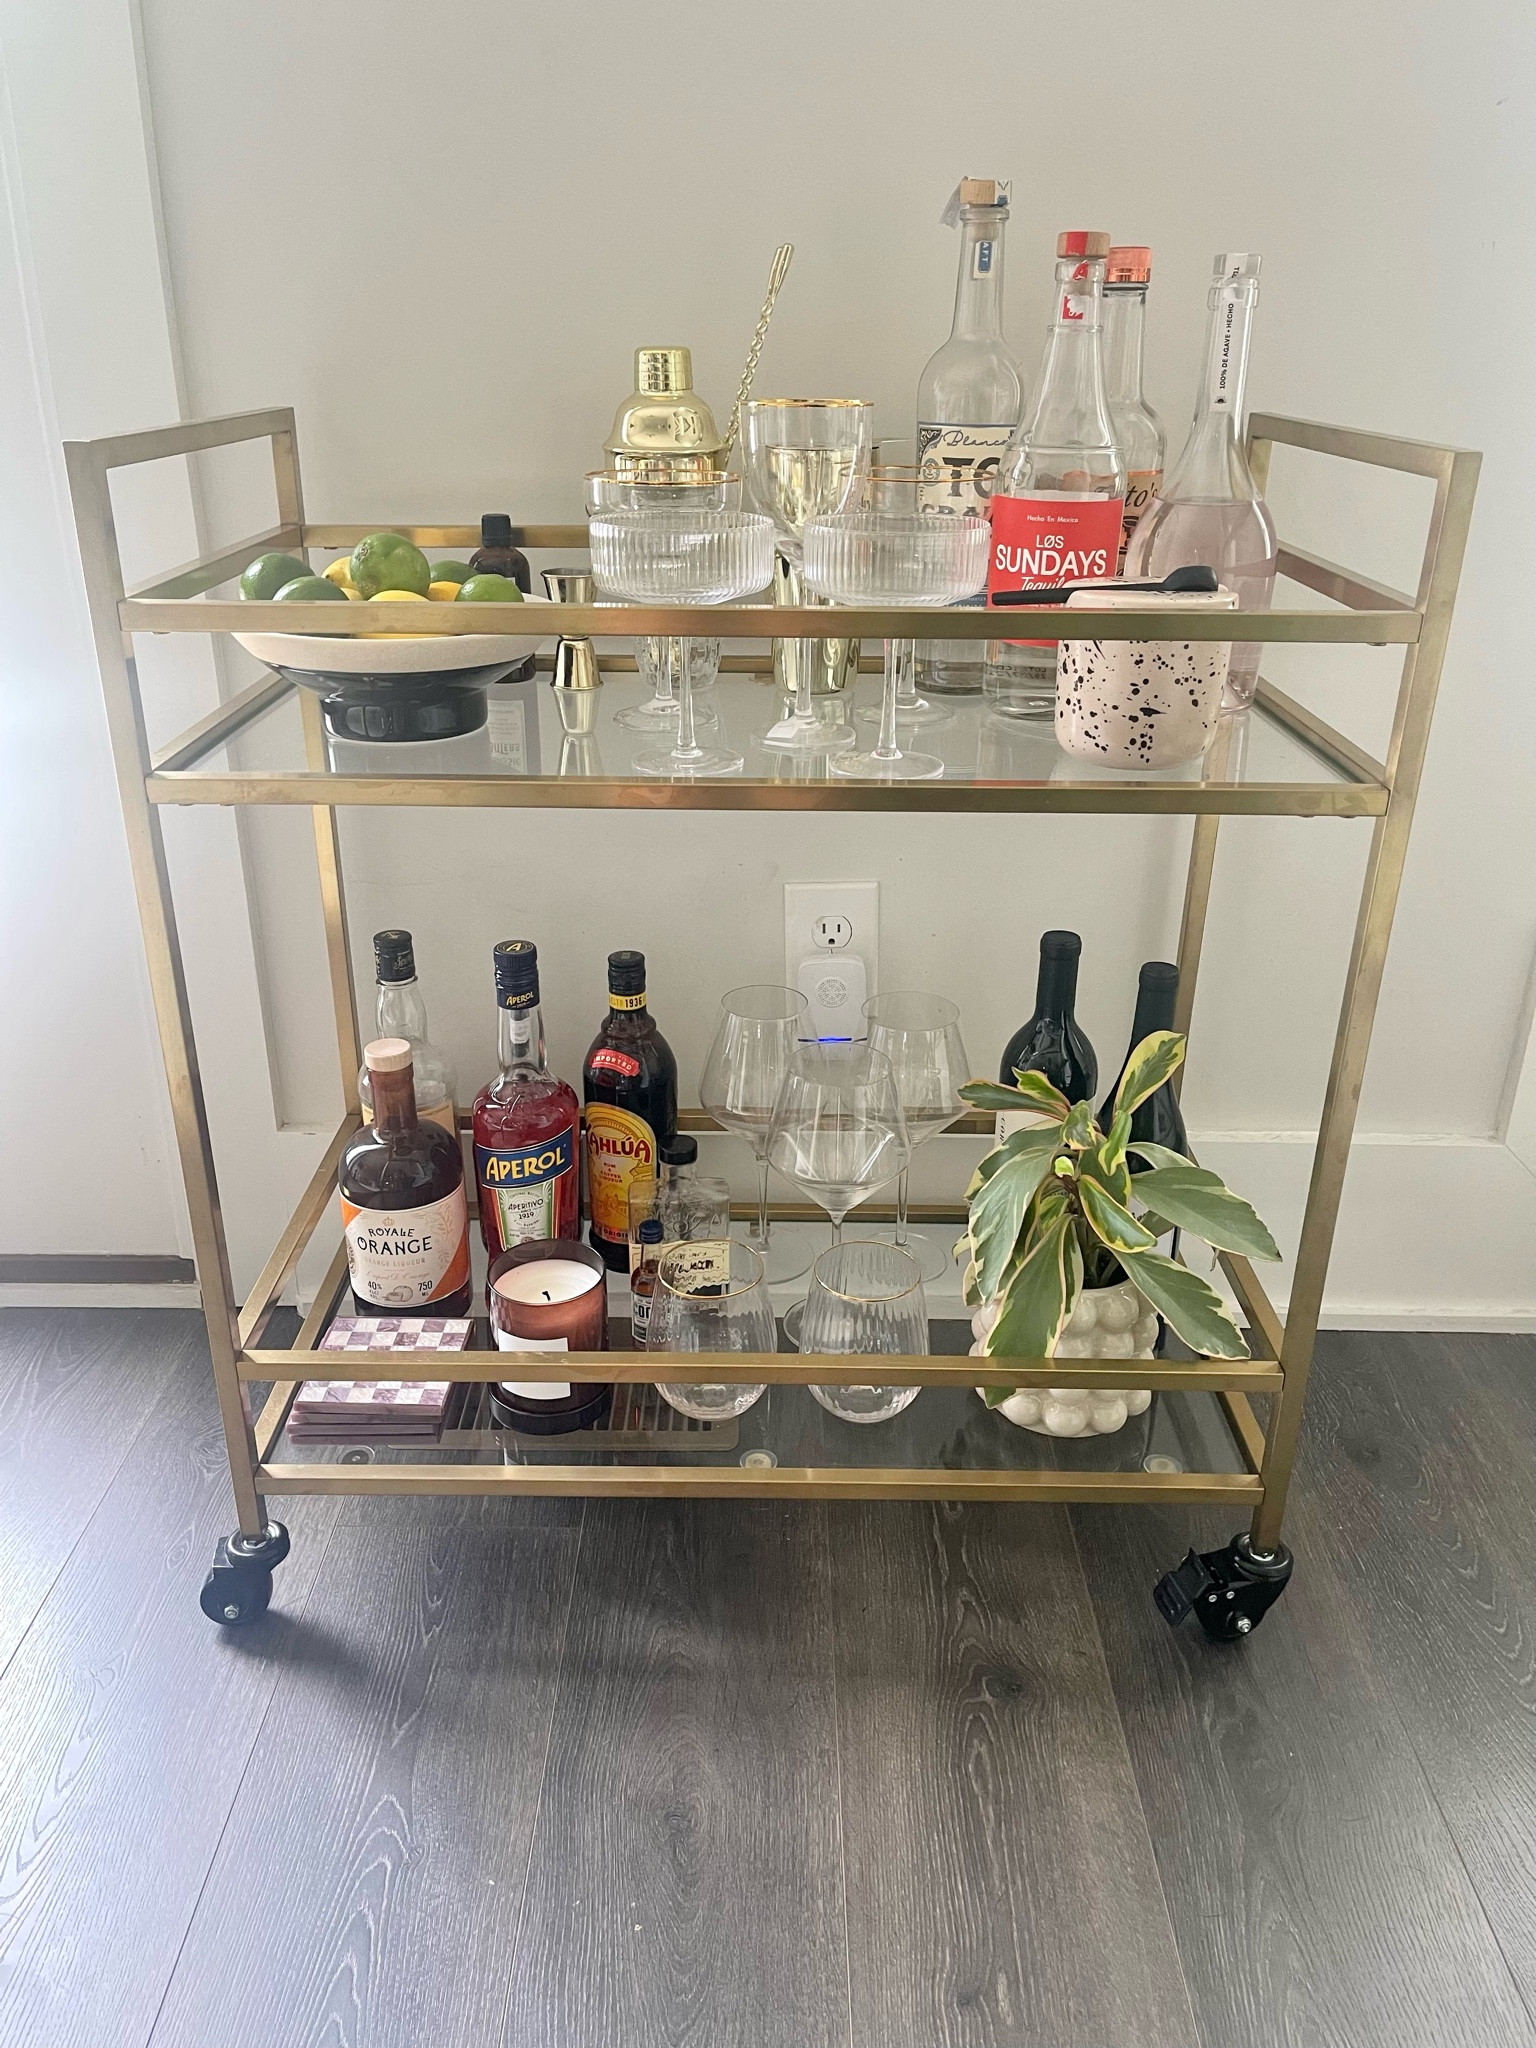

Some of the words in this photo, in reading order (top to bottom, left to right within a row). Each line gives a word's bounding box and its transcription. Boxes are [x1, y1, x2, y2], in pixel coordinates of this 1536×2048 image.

[1226, 303, 1235, 328] HECHO
[1223, 334, 1231, 357] AGAVE
[1222, 358, 1228, 368] DE
[1219, 369, 1227, 389] 100%
[1036, 535, 1064, 548] LØS
[996, 544, 1107, 576] SUNDAYS
[1021, 577, 1065, 590] Tequil
[506, 943, 522, 951] A
[506, 992, 534, 1006] APEROL
[625, 996, 642, 1008] 1936
[487, 1147, 565, 1181] APEROL
[508, 1198, 544, 1210] APERITIVO
[368, 1228, 415, 1237] ROYALE
[357, 1236, 432, 1255] ORANGE
[368, 1281, 382, 1290] 40%
[418, 1280, 433, 1291] 750
